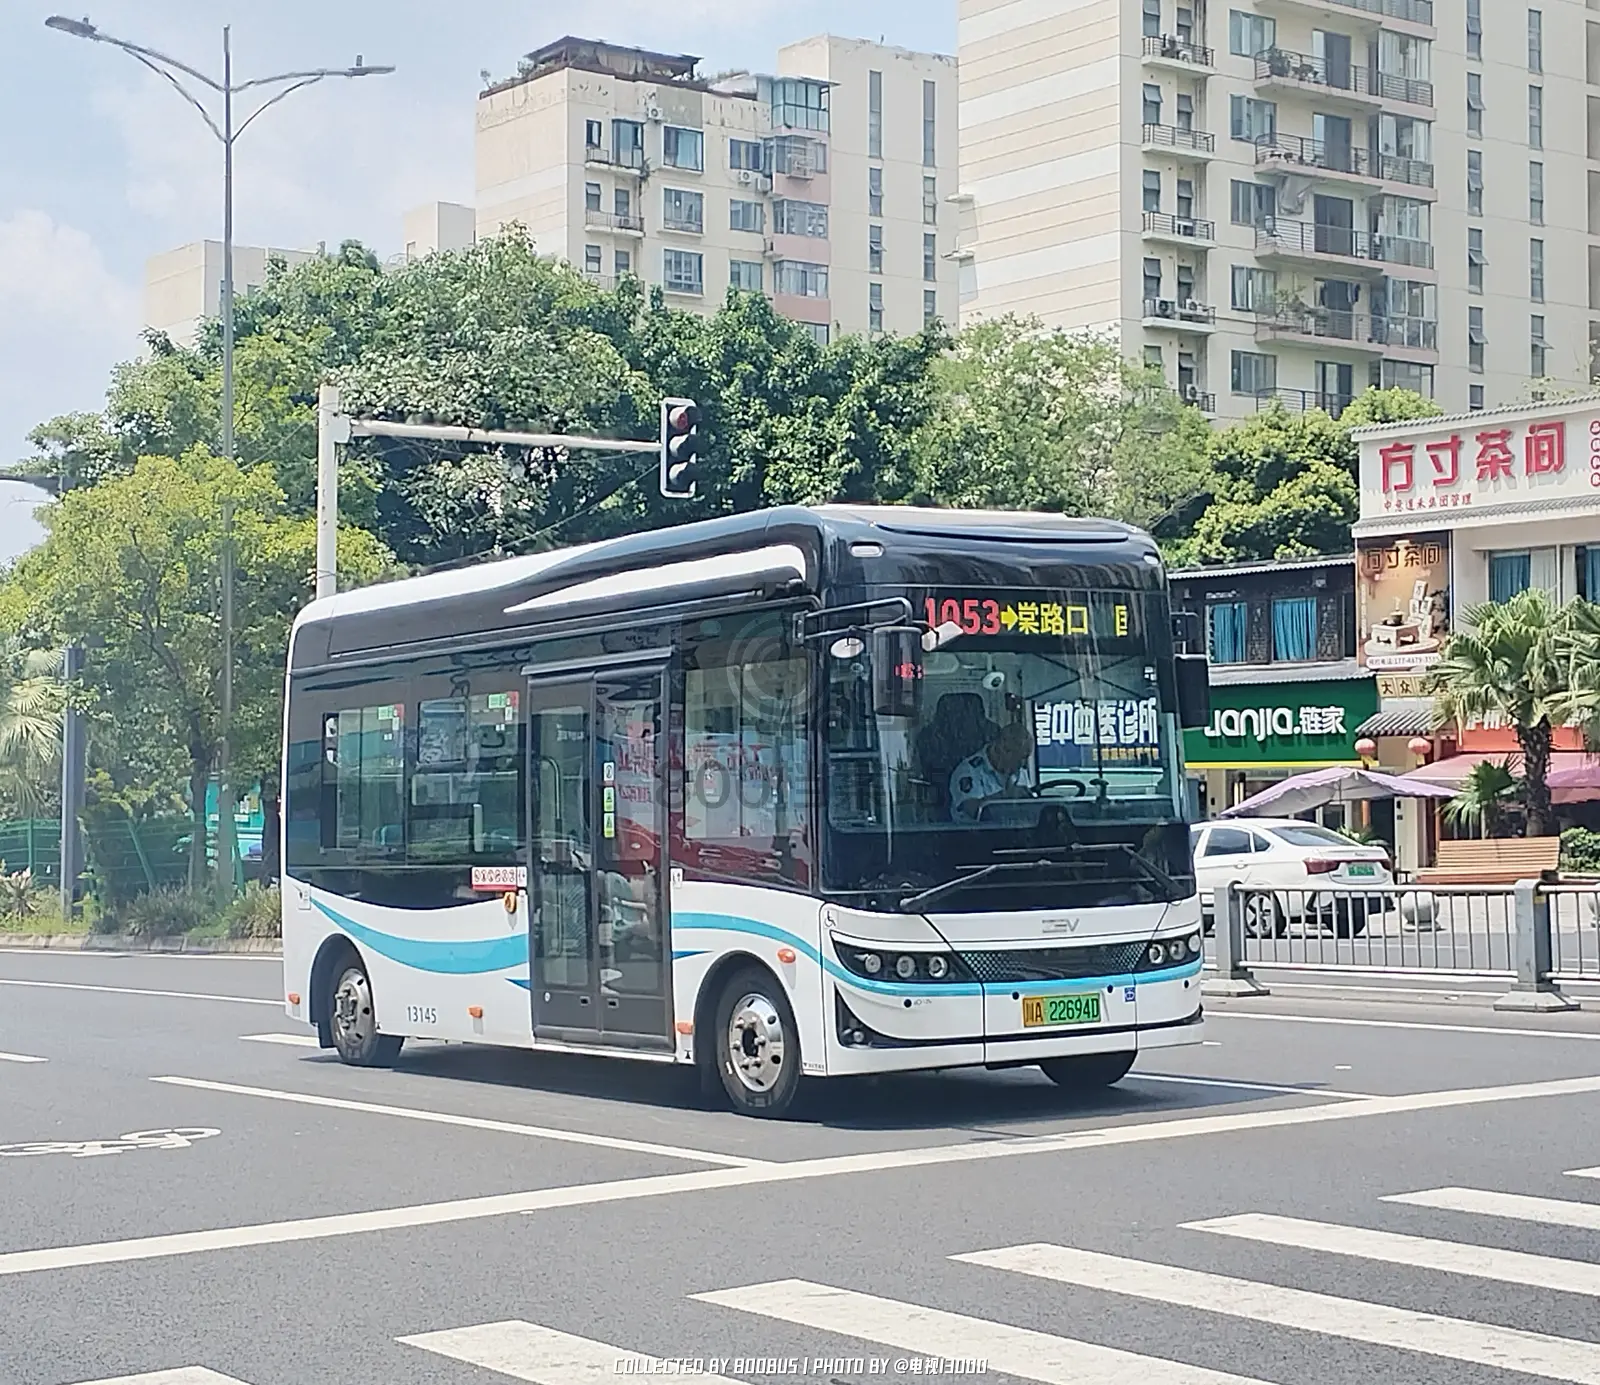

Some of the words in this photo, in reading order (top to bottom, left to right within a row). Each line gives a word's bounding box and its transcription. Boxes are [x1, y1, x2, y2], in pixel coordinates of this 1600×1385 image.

[1378, 421, 1566, 494] 方寸茶间
[925, 598, 1000, 635] 1053
[1017, 601, 1089, 636] 棠路口
[407, 1005, 437, 1024] 13145
